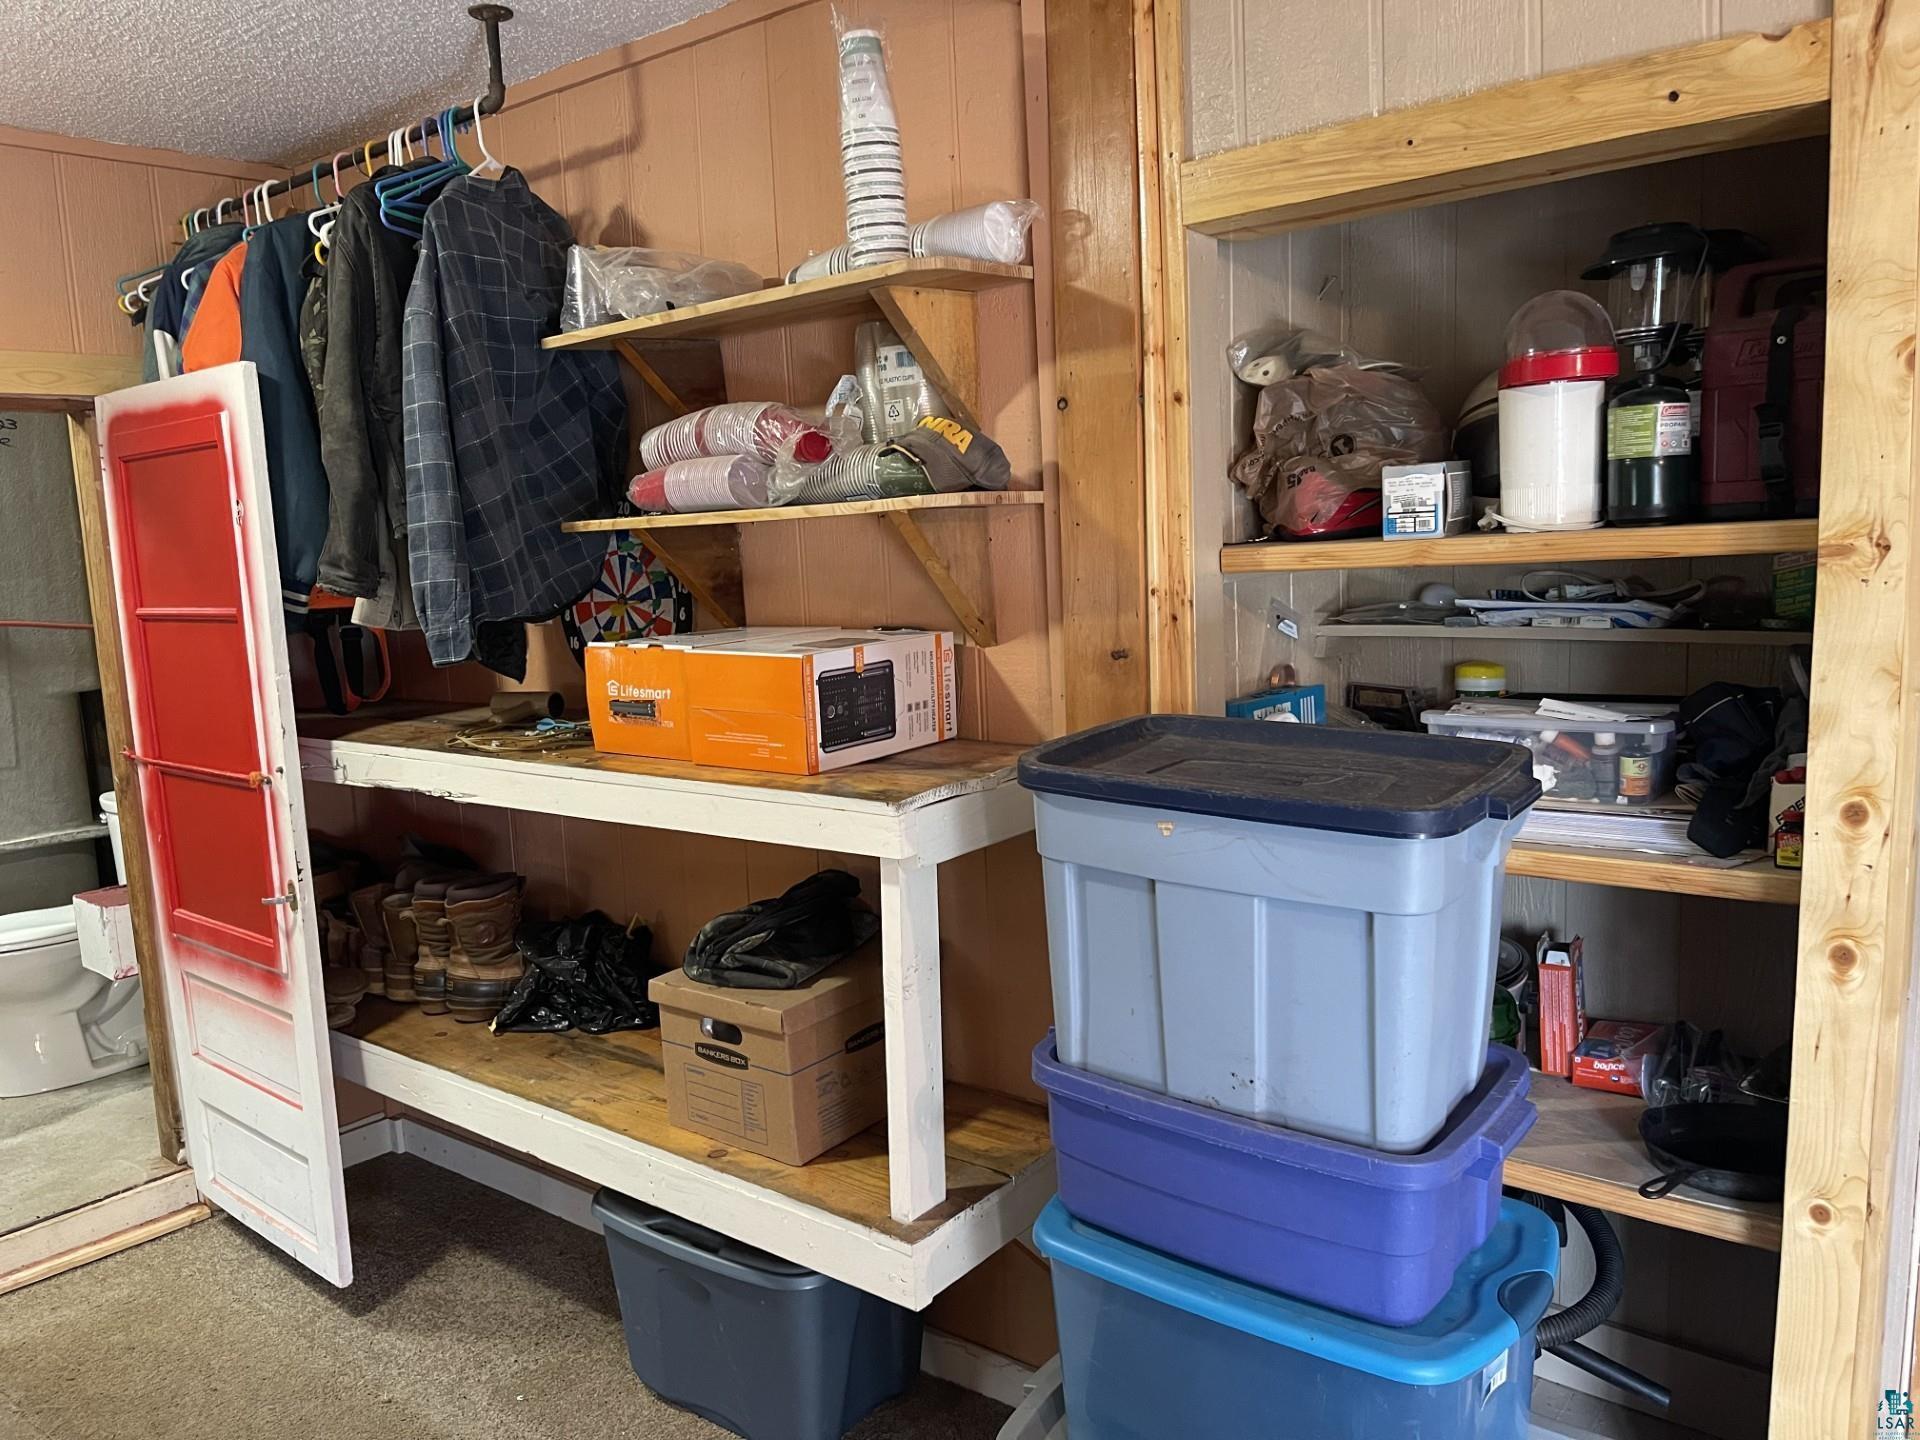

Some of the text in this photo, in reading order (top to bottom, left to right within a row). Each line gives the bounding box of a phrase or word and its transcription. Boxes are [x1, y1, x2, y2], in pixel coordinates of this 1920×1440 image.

[917, 415, 974, 455] NRA
[564, 608, 571, 622] 8
[679, 606, 686, 622] 6
[569, 636, 579, 650] 16
[620, 684, 671, 700] Lifesmart
[943, 665, 953, 732] Lifesmart
[697, 1045, 746, 1066] BANKERS BOX
[1593, 1060, 1625, 1071] bounce
